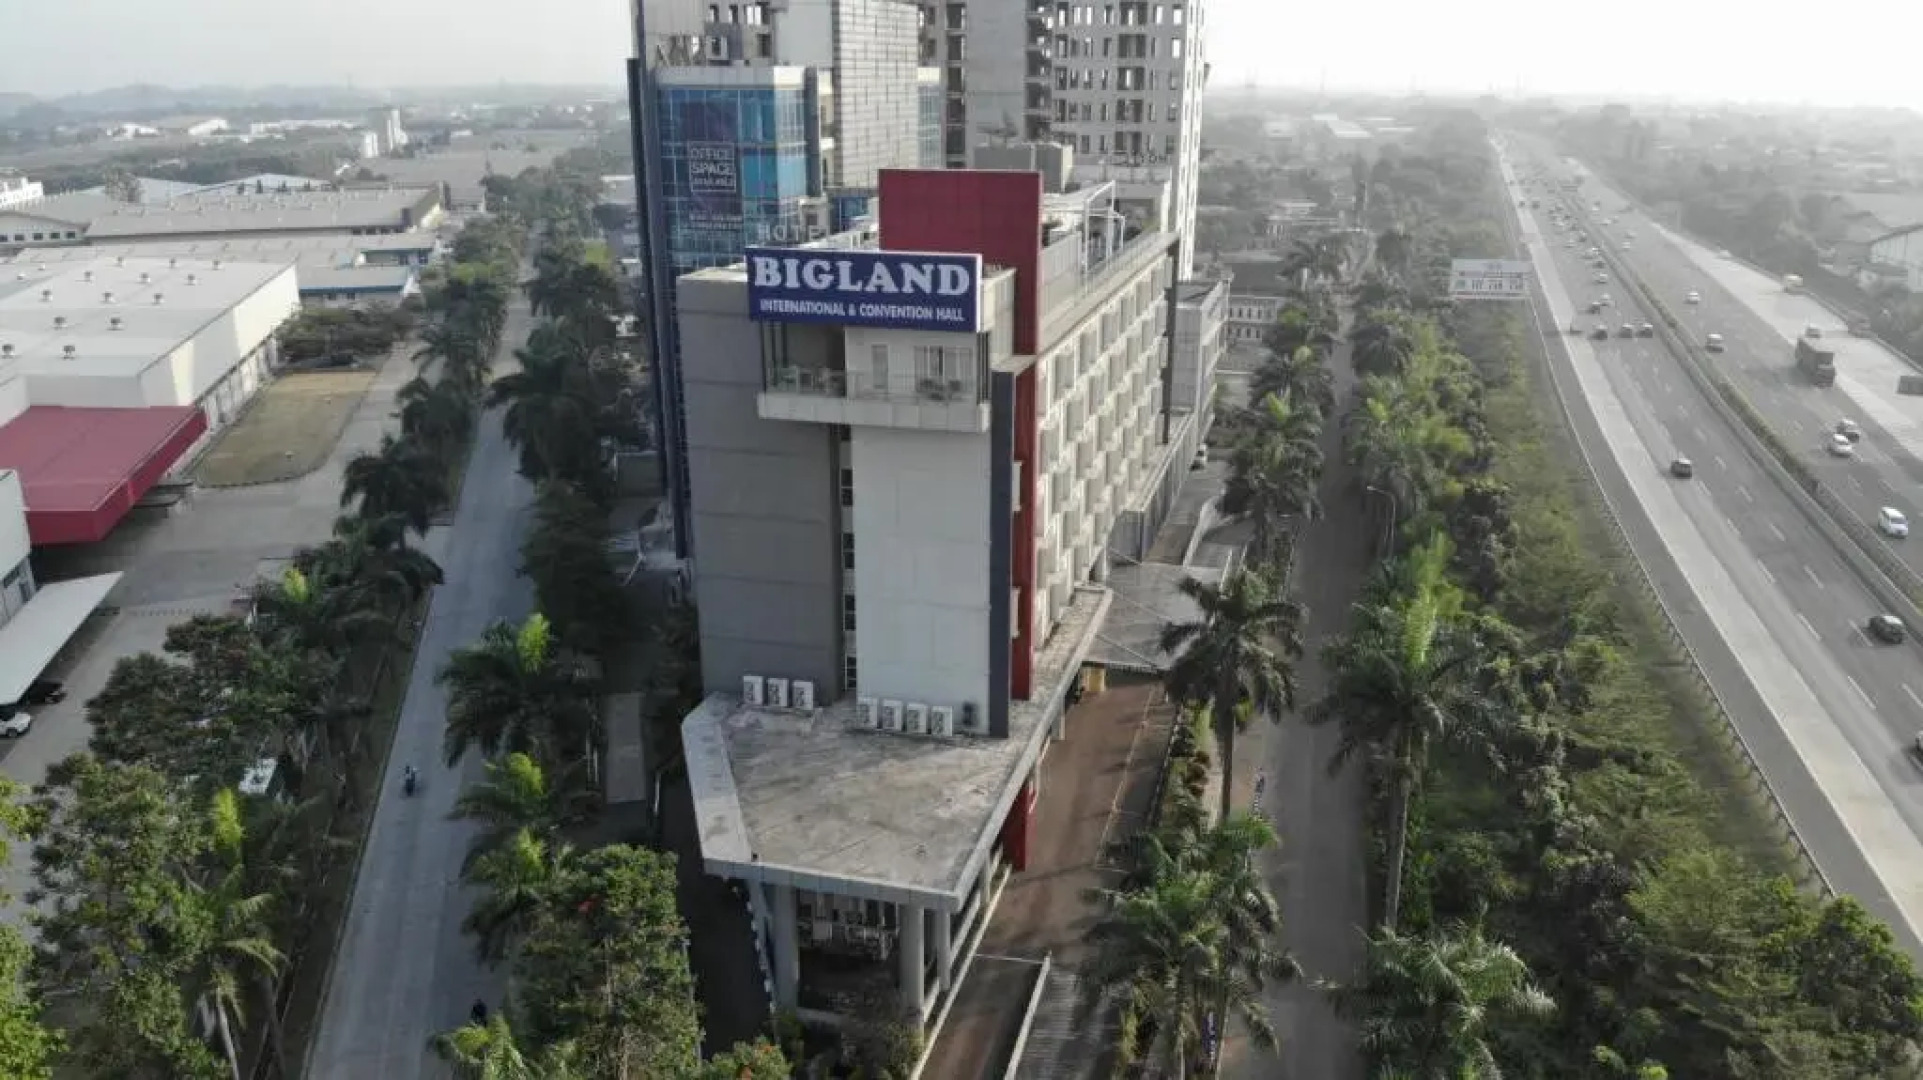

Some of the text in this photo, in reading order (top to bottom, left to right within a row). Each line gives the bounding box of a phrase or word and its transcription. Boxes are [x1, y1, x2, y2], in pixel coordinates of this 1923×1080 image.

[691, 147, 732, 160] OFFICE
[691, 161, 733, 175] SPACE
[752, 256, 970, 296] BIGLAND
[759, 298, 965, 322] INTERNATIONAL & CONVENTION HALL
